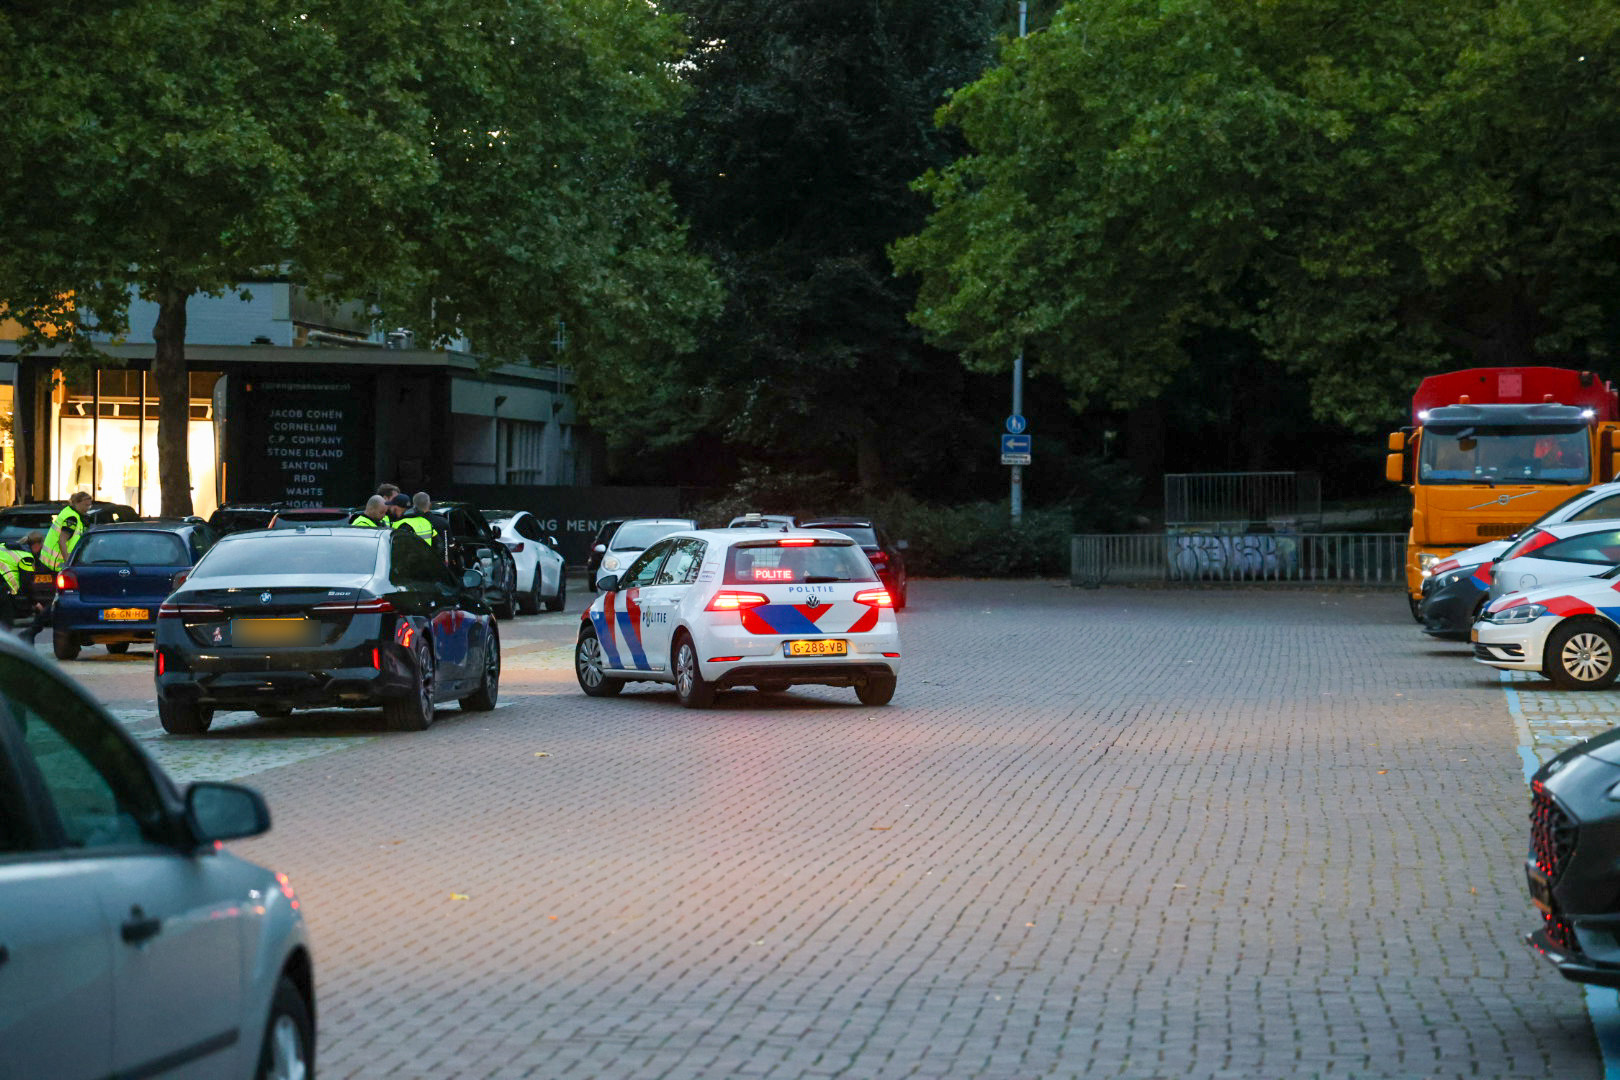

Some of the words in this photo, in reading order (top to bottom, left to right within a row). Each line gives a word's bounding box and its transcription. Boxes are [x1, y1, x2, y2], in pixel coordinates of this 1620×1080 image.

[270, 410, 303, 418] JACOB
[274, 422, 337, 432] CORNELIANI
[291, 435, 342, 444] COMPANY
[267, 448, 301, 456] STONE
[306, 449, 343, 457] ISLAND
[281, 461, 328, 470] SANTONI
[294, 474, 316, 482] RRD
[755, 570, 792, 579] POLITIE
[793, 642, 843, 653] G-288-VB
